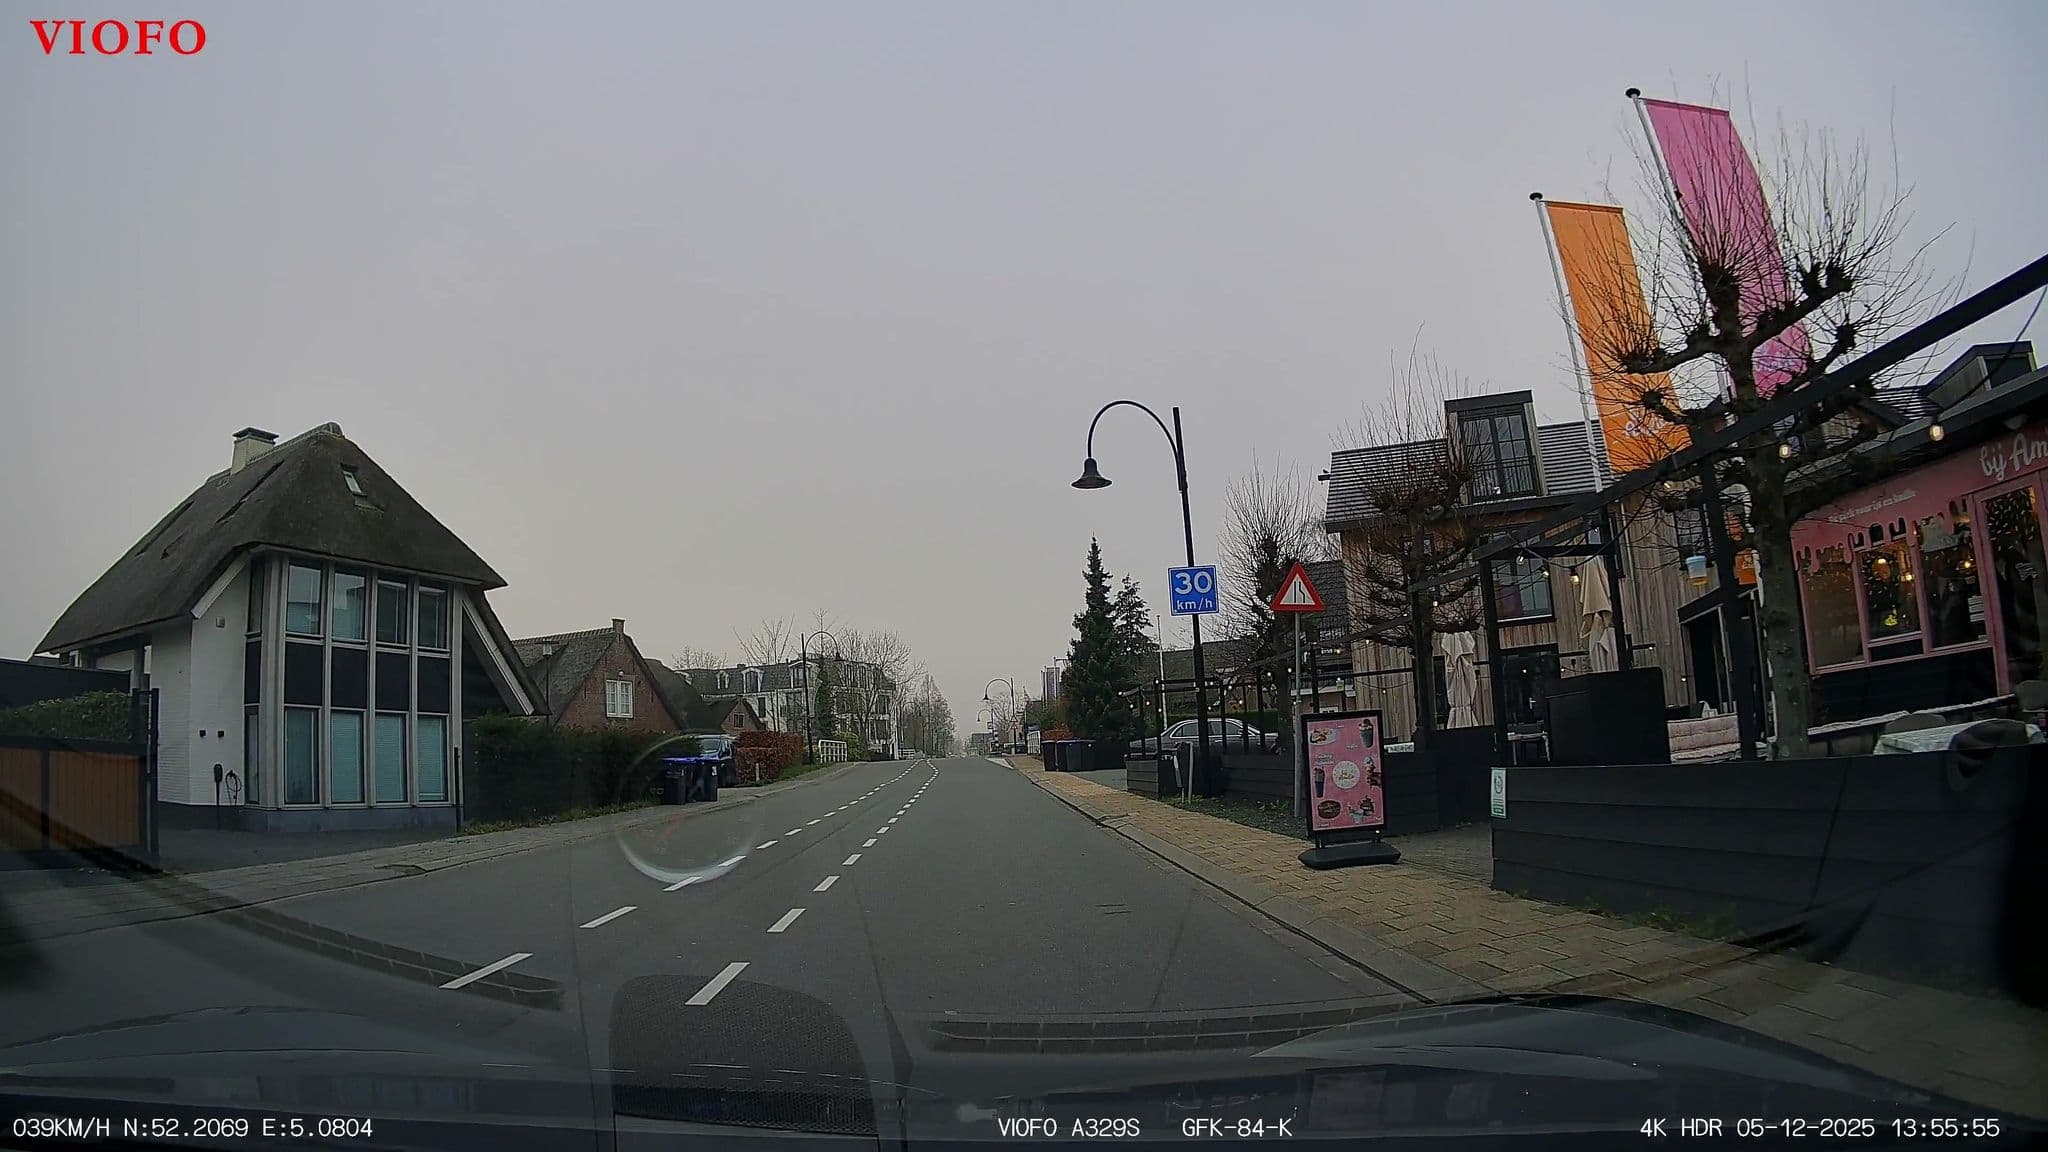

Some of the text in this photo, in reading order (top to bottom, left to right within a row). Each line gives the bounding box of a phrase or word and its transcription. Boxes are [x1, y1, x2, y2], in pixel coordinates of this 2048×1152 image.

[1979, 442, 2007, 481] bij
[1174, 571, 1213, 595] 30
[1177, 597, 1213, 611] km/h
